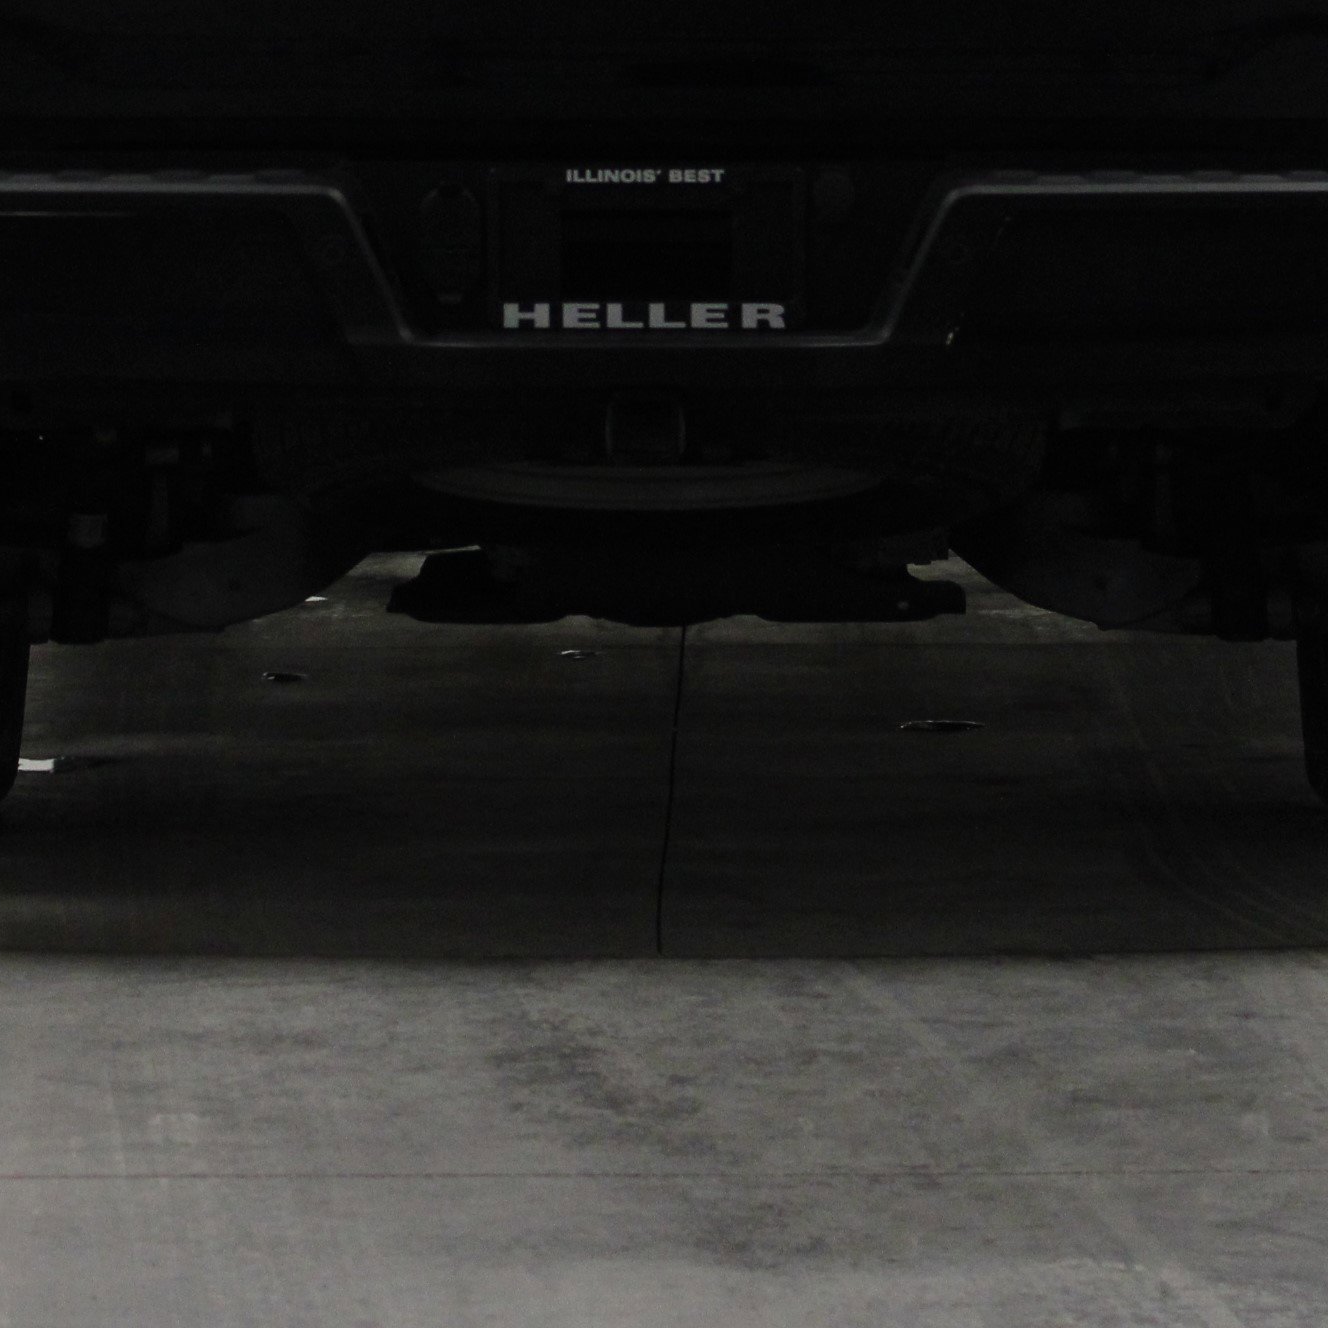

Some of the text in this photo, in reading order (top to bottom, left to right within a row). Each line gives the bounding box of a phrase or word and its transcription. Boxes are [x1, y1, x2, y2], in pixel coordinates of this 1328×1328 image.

[566, 168, 725, 184] ILLINOIS' BEST
[503, 302, 785, 329] HELLER
